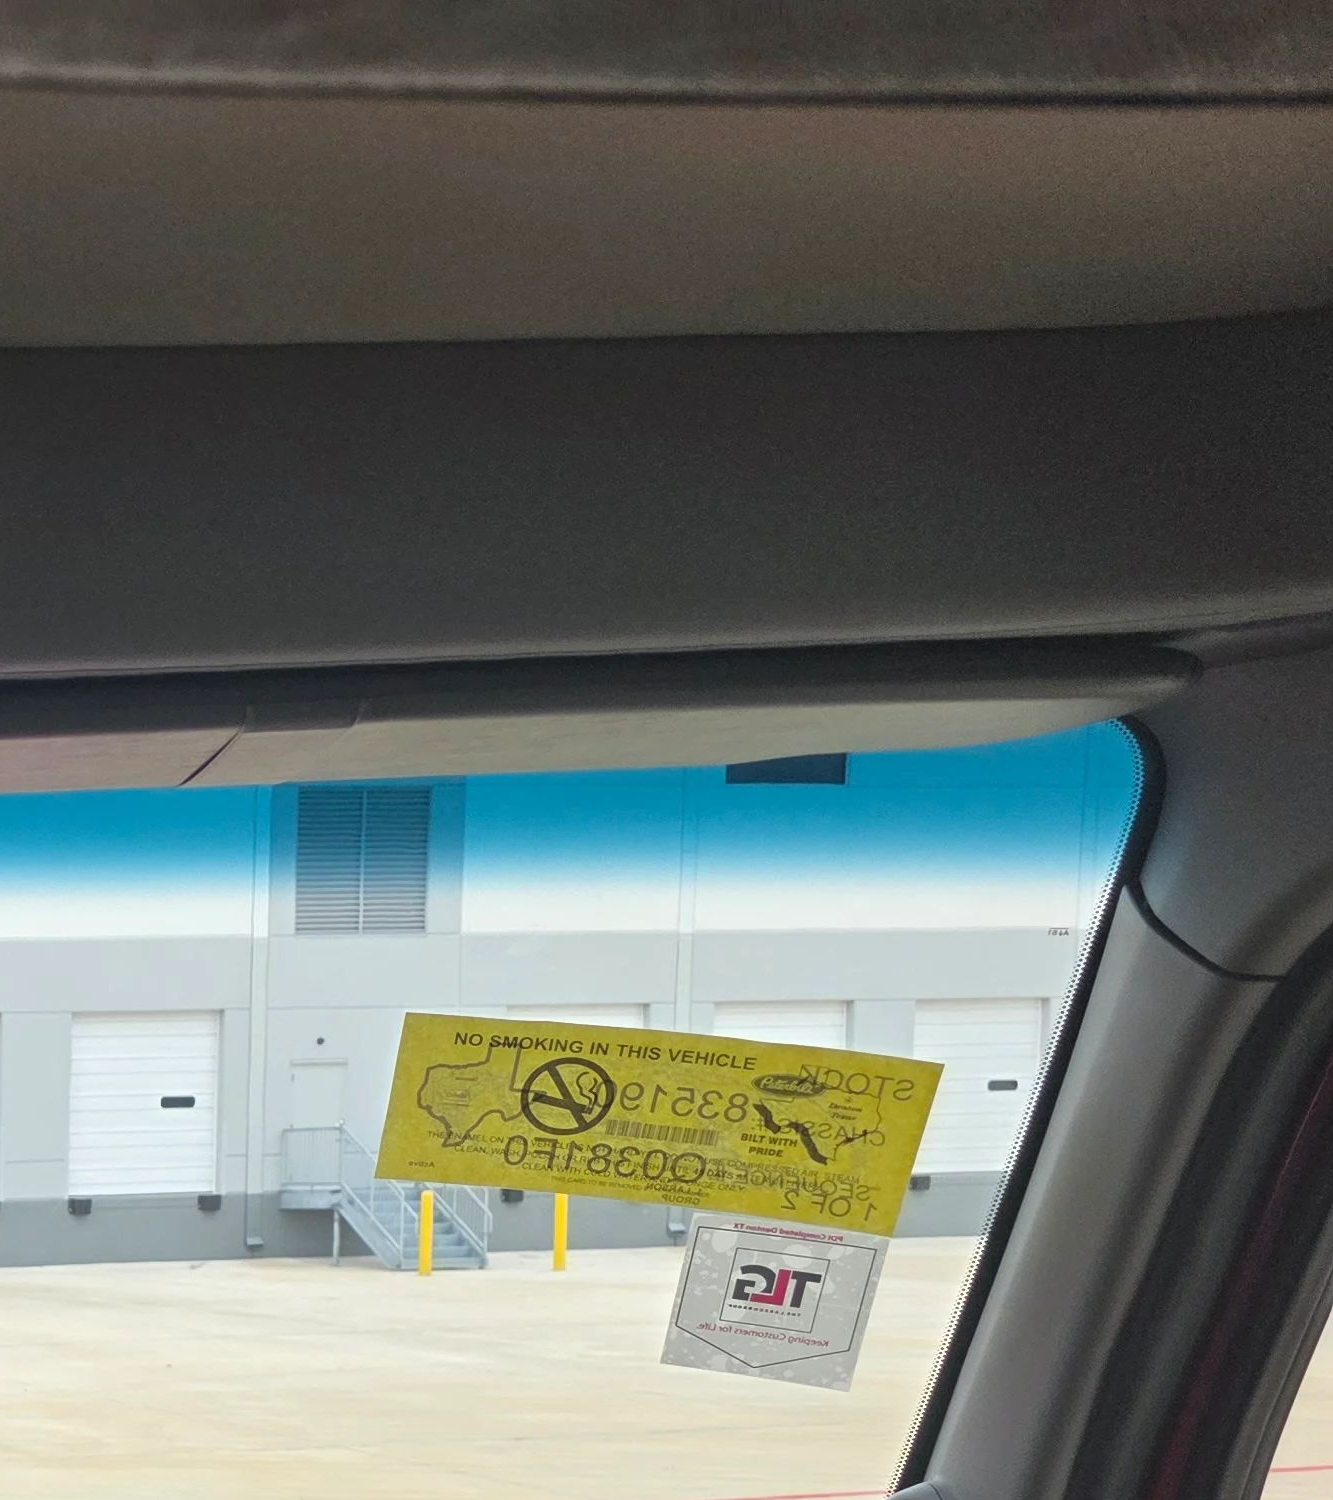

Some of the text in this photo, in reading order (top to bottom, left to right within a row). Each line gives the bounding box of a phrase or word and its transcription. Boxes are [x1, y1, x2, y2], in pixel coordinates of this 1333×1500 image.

[454, 1032, 757, 1071] NO SMOKING IN THIS VEHICLE
[741, 1133, 798, 1148] BILT WITH
[748, 1146, 783, 1158] PRIDE
